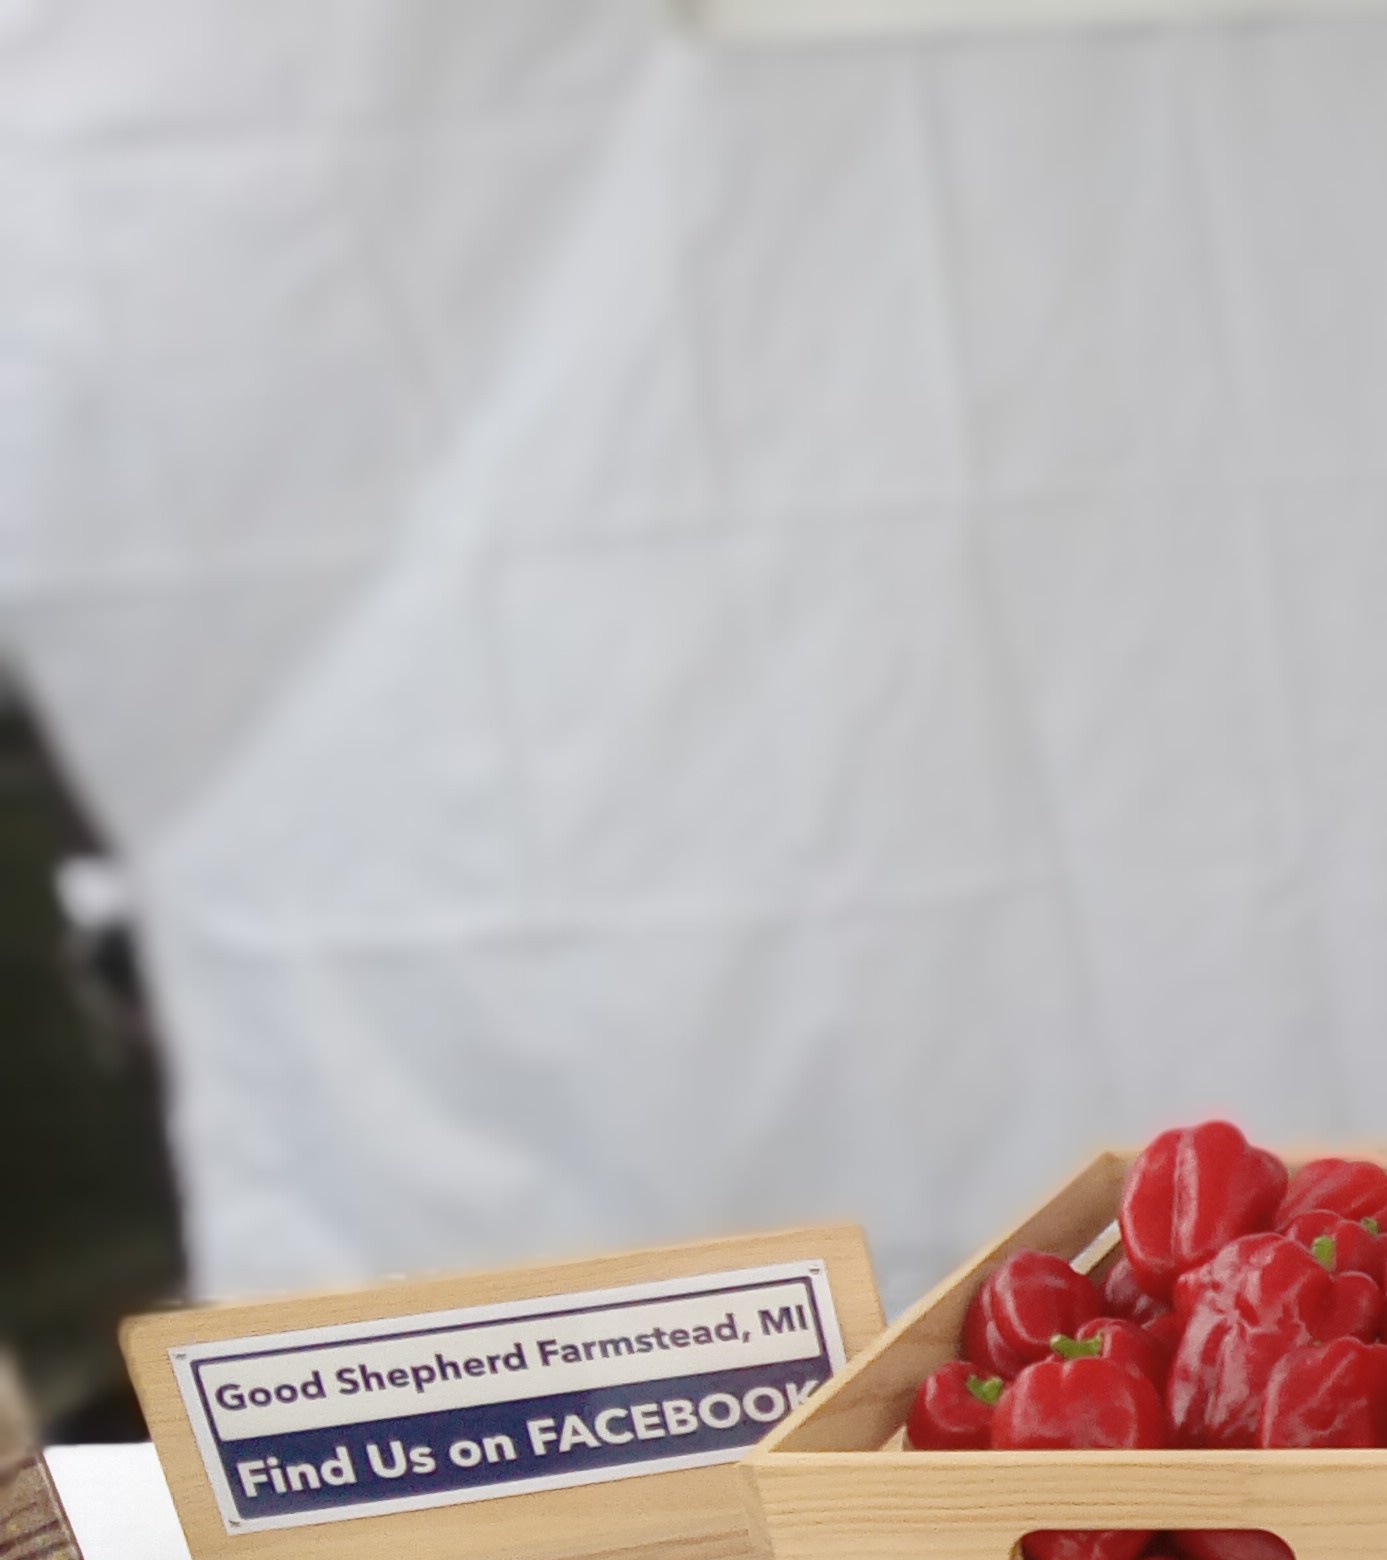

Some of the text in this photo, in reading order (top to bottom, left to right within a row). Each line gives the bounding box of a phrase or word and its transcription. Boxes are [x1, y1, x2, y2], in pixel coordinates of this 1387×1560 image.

[213, 1303, 809, 1411] Good Shepherd Farmstead, MI
[236, 1379, 821, 1499] Find Us on FACEBOOK
